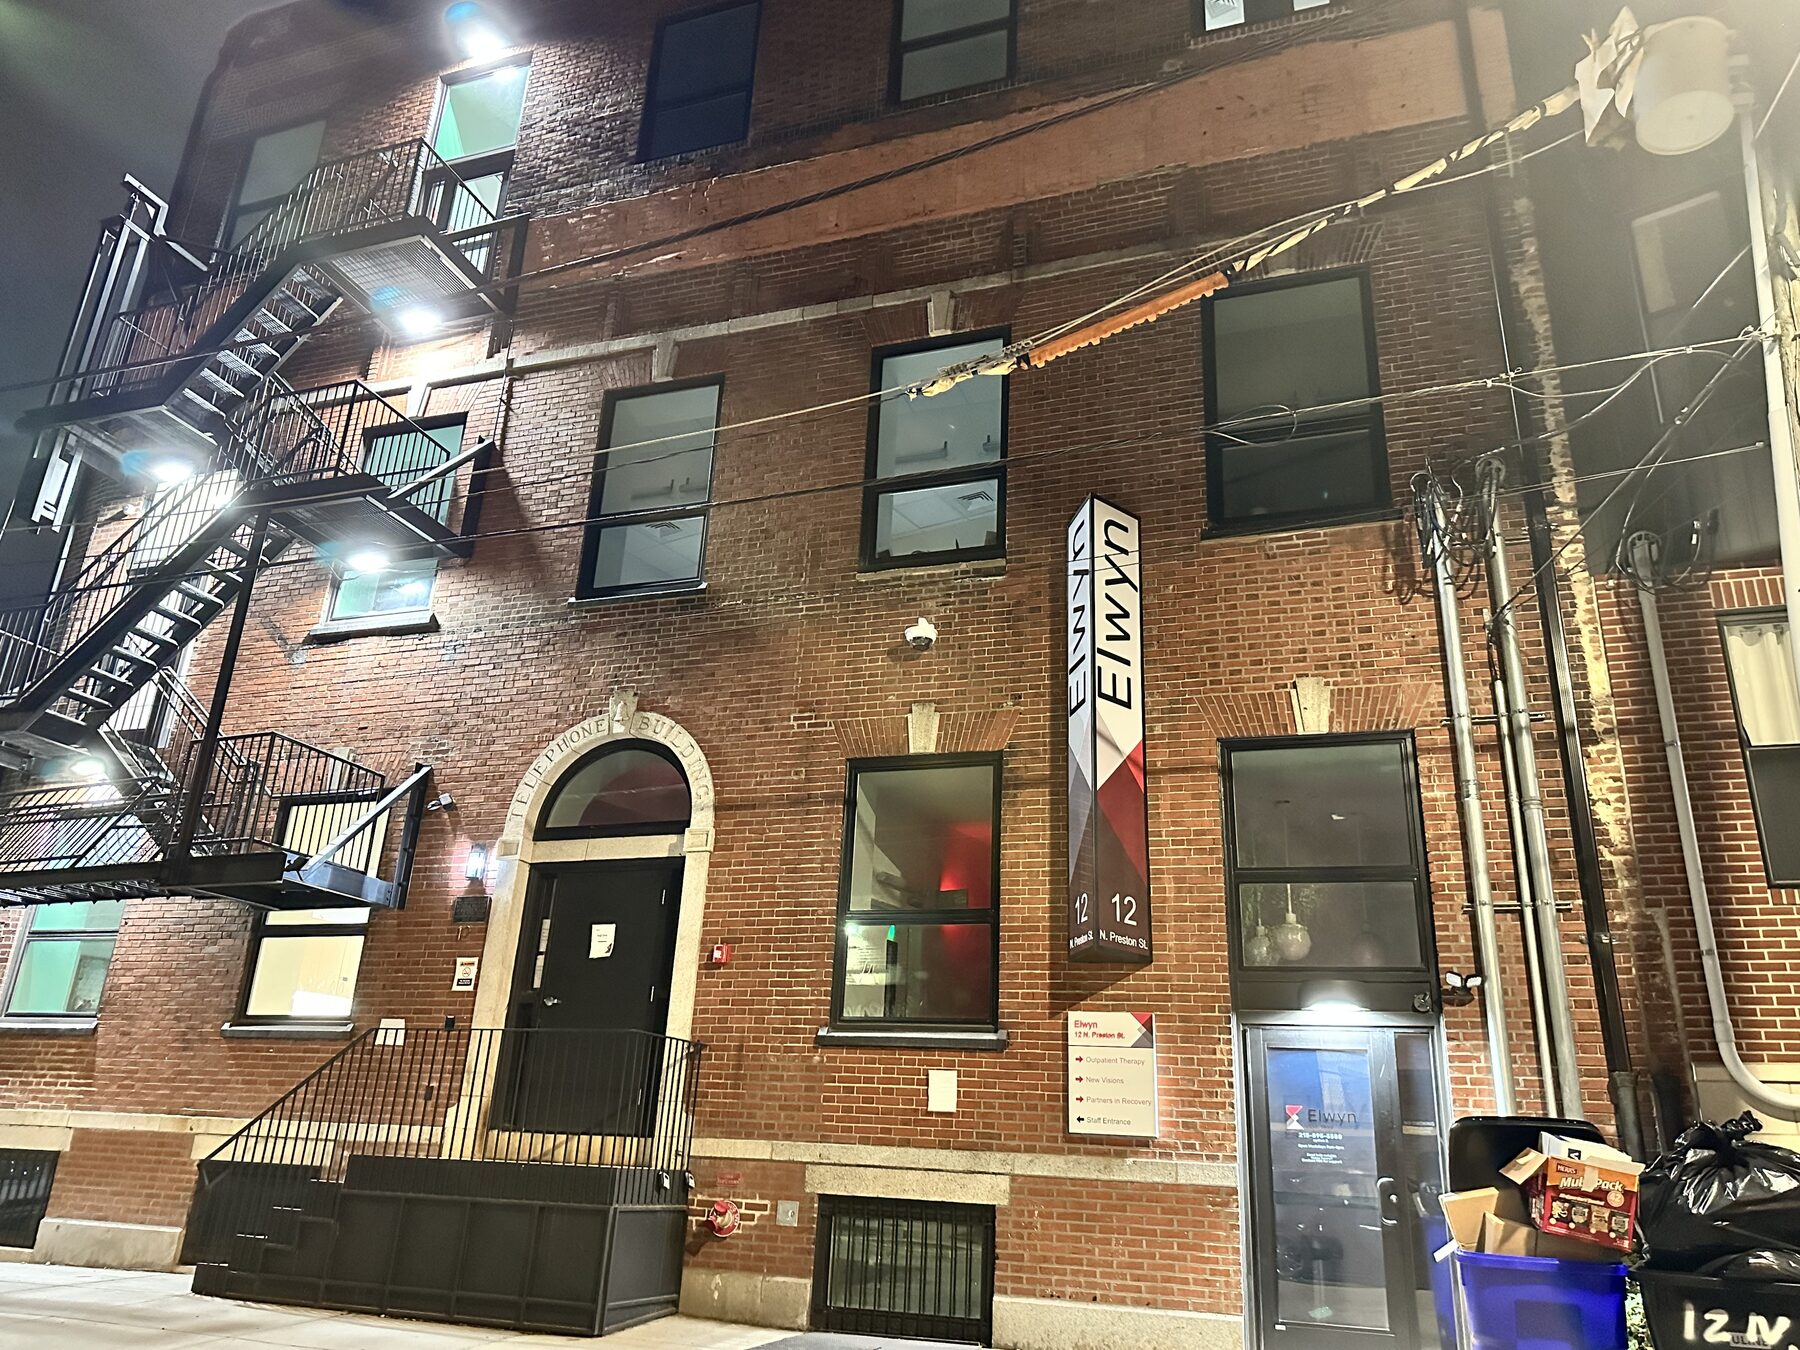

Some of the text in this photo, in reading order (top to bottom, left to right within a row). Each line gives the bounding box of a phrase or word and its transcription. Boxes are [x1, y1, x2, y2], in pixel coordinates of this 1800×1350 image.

[1069, 519, 1090, 718] Elwyn
[1096, 518, 1139, 711] Elwyn
[509, 716, 710, 822] TELEPHONE BUILDING
[1074, 892, 1088, 925] 12
[1111, 892, 1138, 926] 12
[1099, 928, 1148, 950] N. Preston St.
[1074, 1020, 1098, 1030] Elwyn
[1086, 1056, 1145, 1066] Outpatient Therapy
[1086, 1096, 1113, 1104] Partners
[1122, 1098, 1152, 1106] Recovery
[1102, 1117, 1132, 1125] Entrance
[1307, 1108, 1357, 1126] Elwyn
[1683, 1302, 1732, 1343] 12
[1732, 1335, 1764, 1346] ULNE
